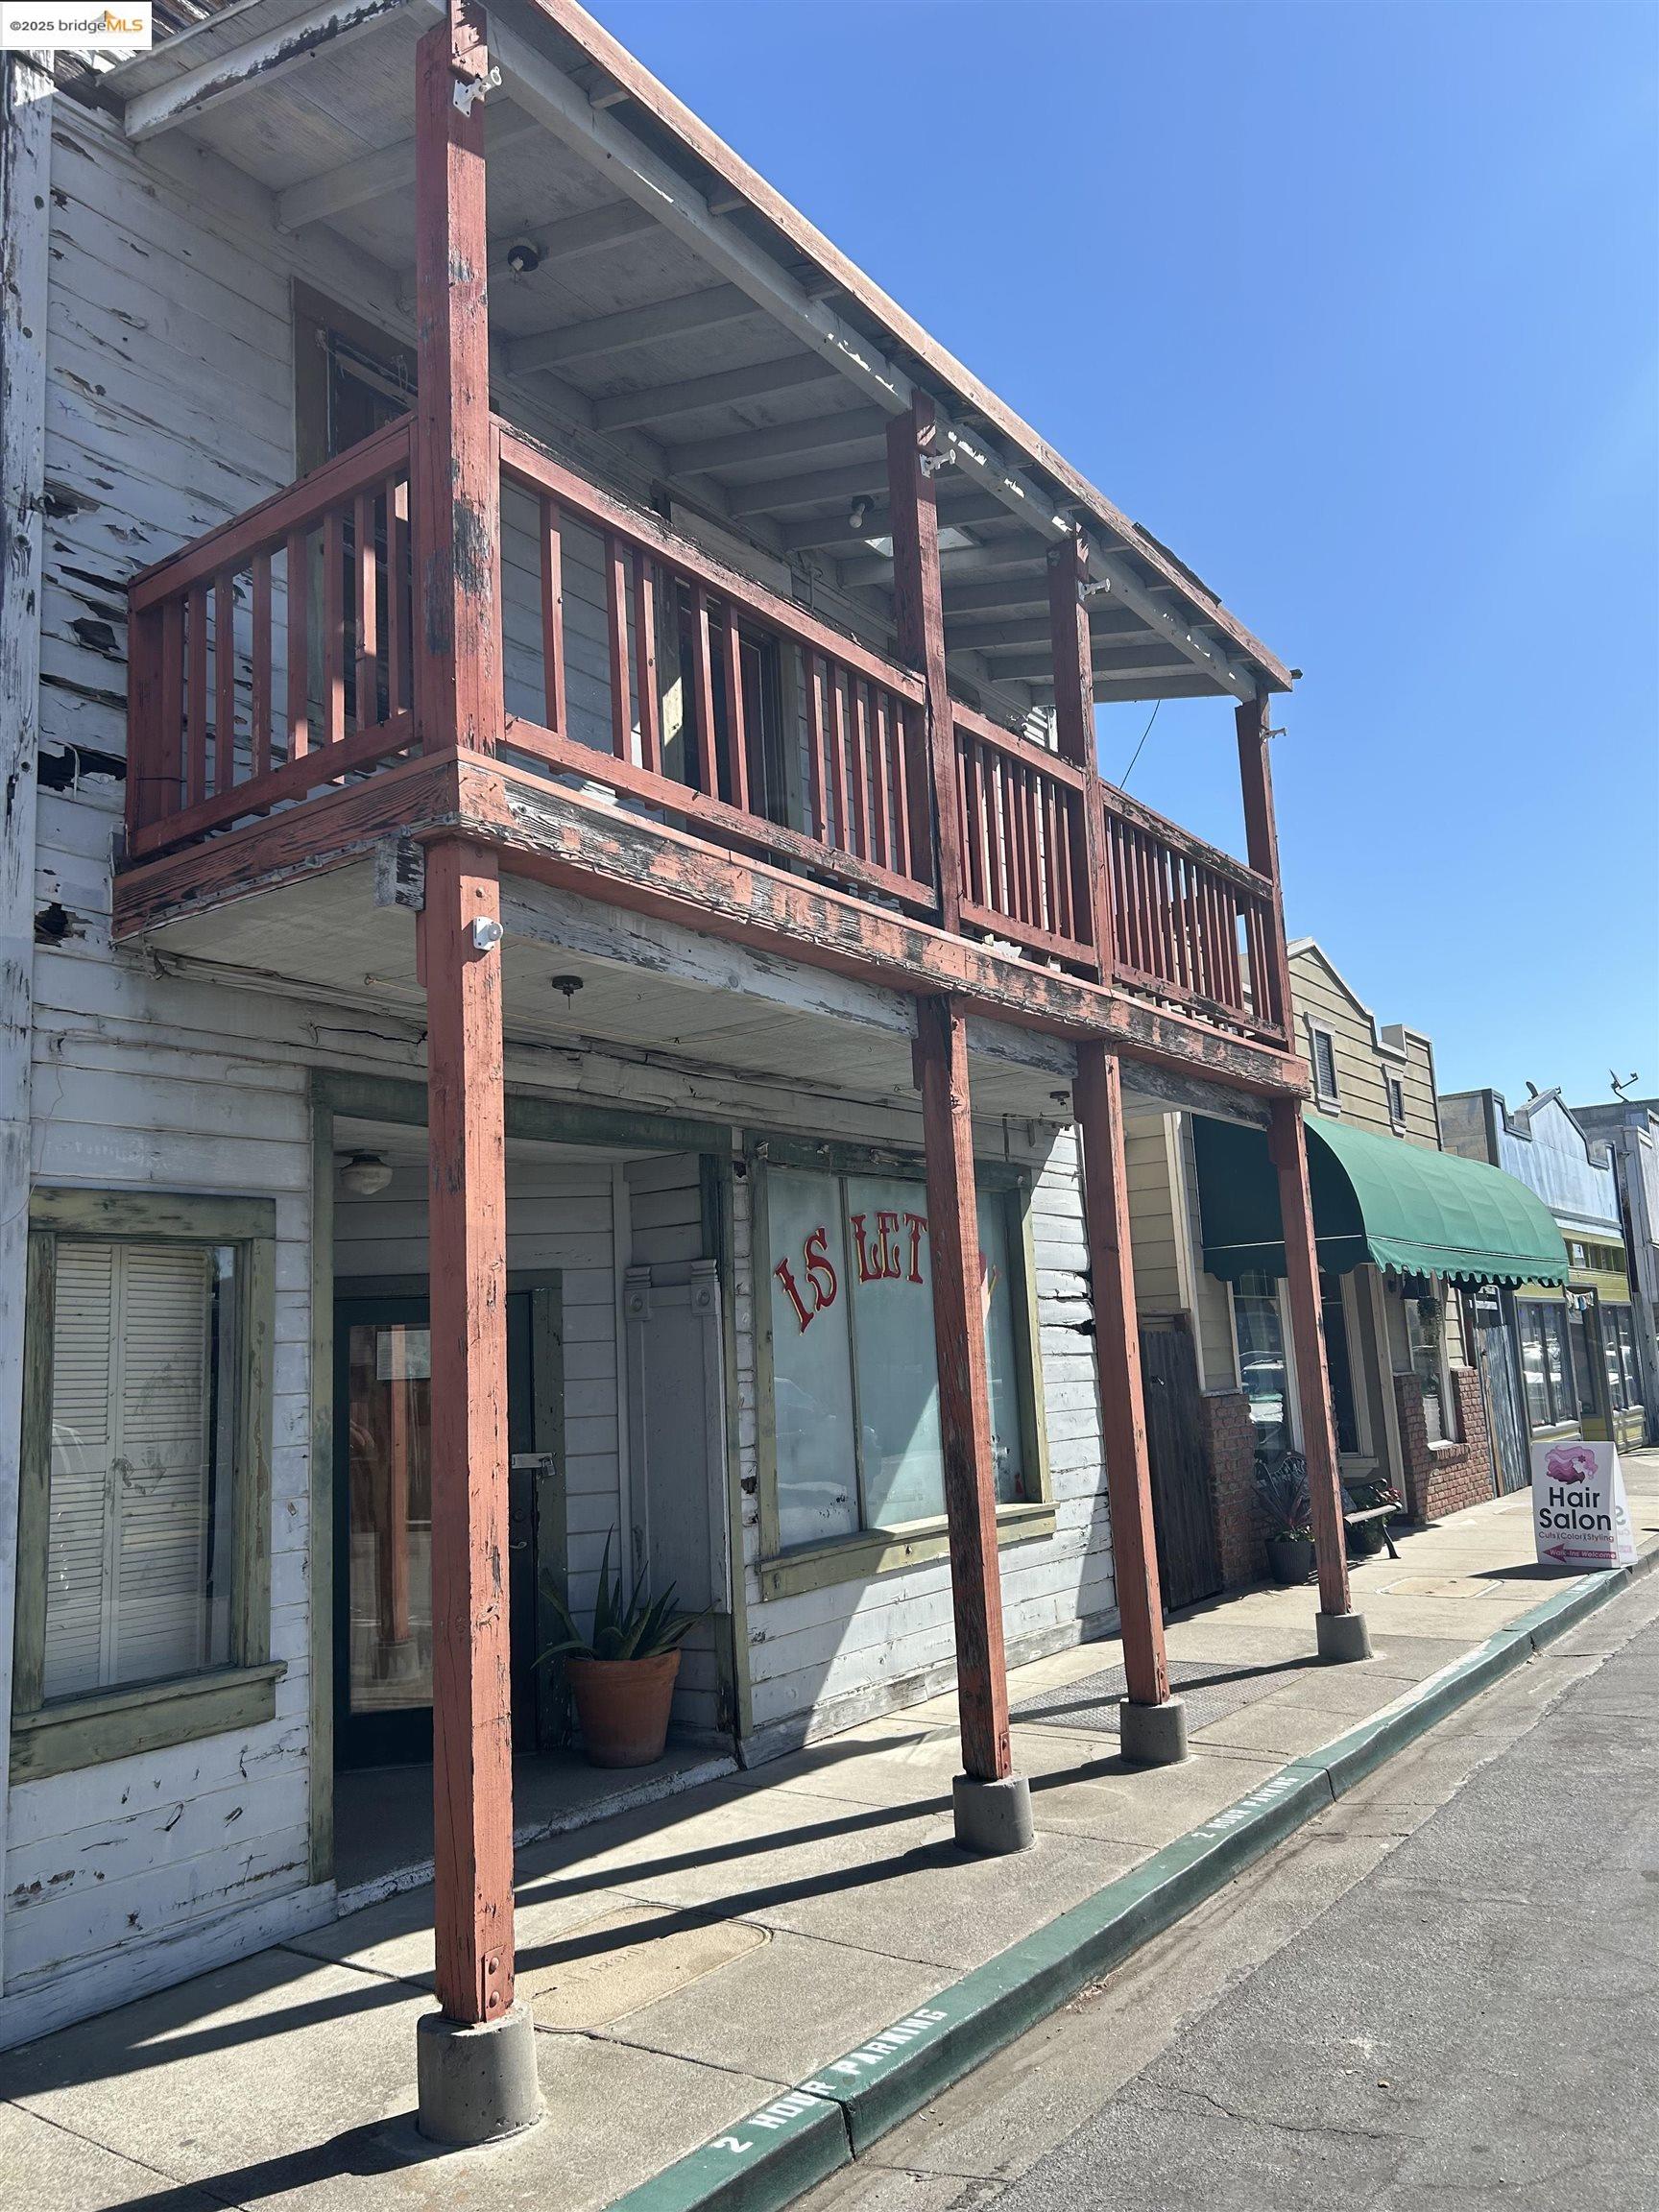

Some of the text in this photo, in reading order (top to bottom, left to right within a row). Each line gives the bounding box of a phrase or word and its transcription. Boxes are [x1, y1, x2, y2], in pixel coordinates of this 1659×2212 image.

[1549, 1486, 1600, 1508] Hair
[1539, 1507, 1612, 1530] Salon
[1581, 1551, 1616, 1559] Welcome
[713, 2008, 948, 2153] 2 HOUR PARKING
